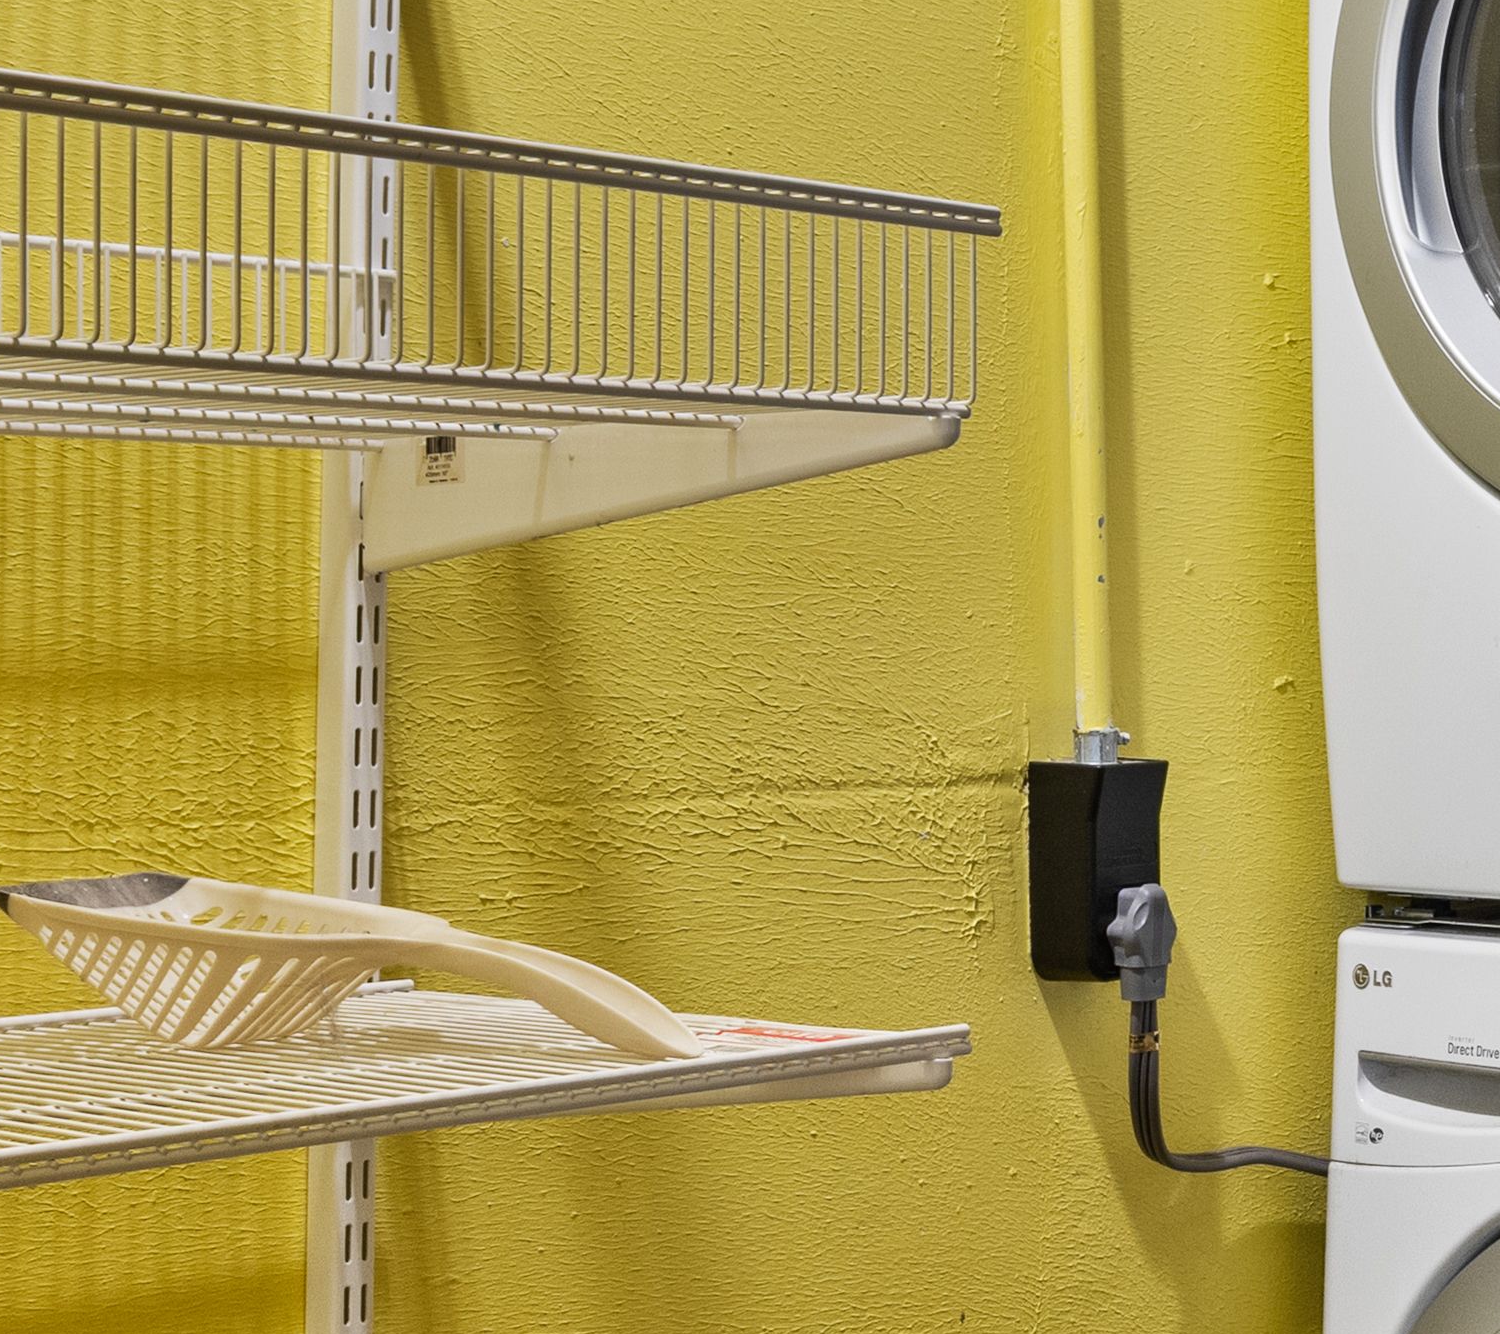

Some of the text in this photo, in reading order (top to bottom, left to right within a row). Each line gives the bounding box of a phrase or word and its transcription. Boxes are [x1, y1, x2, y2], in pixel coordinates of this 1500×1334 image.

[1373, 969, 1392, 988] LG
[1447, 1042, 1500, 1059] Direct Drive
